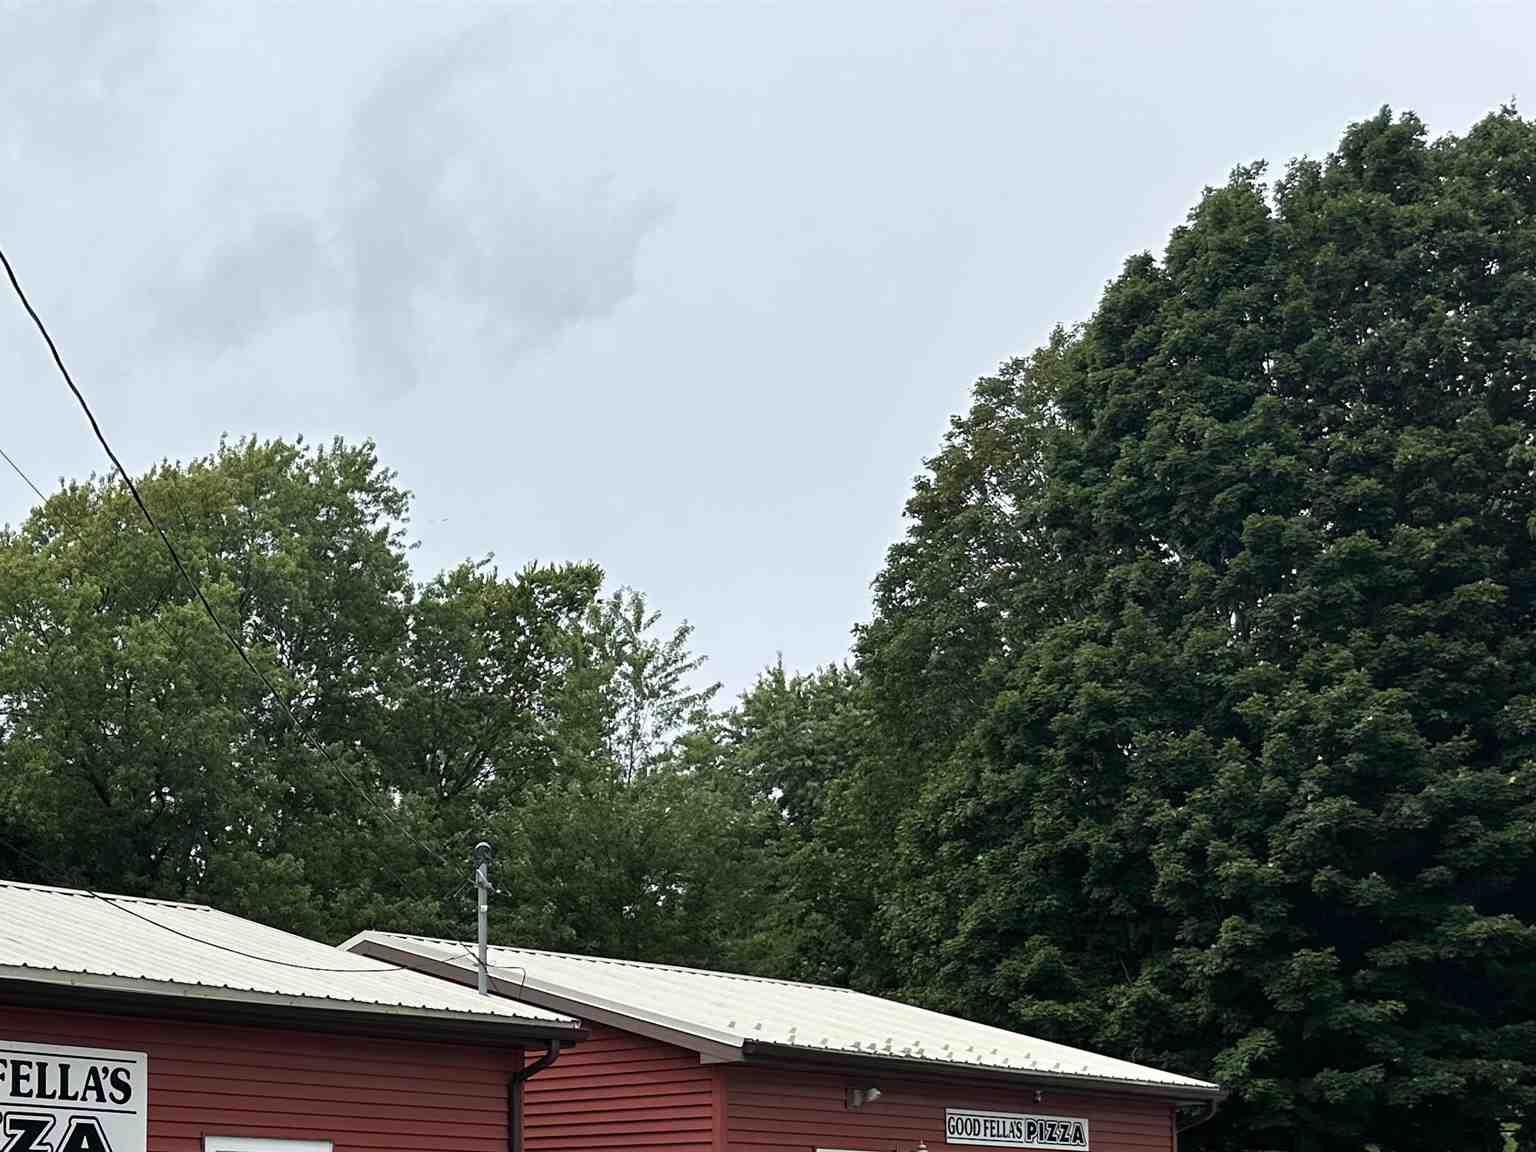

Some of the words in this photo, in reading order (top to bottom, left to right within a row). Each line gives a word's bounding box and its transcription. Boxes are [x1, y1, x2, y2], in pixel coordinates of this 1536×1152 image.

[947, 1116, 981, 1136] GOOD
[983, 1119, 1023, 1140] FELLA'S
[1024, 1118, 1087, 1147] PIZZA
